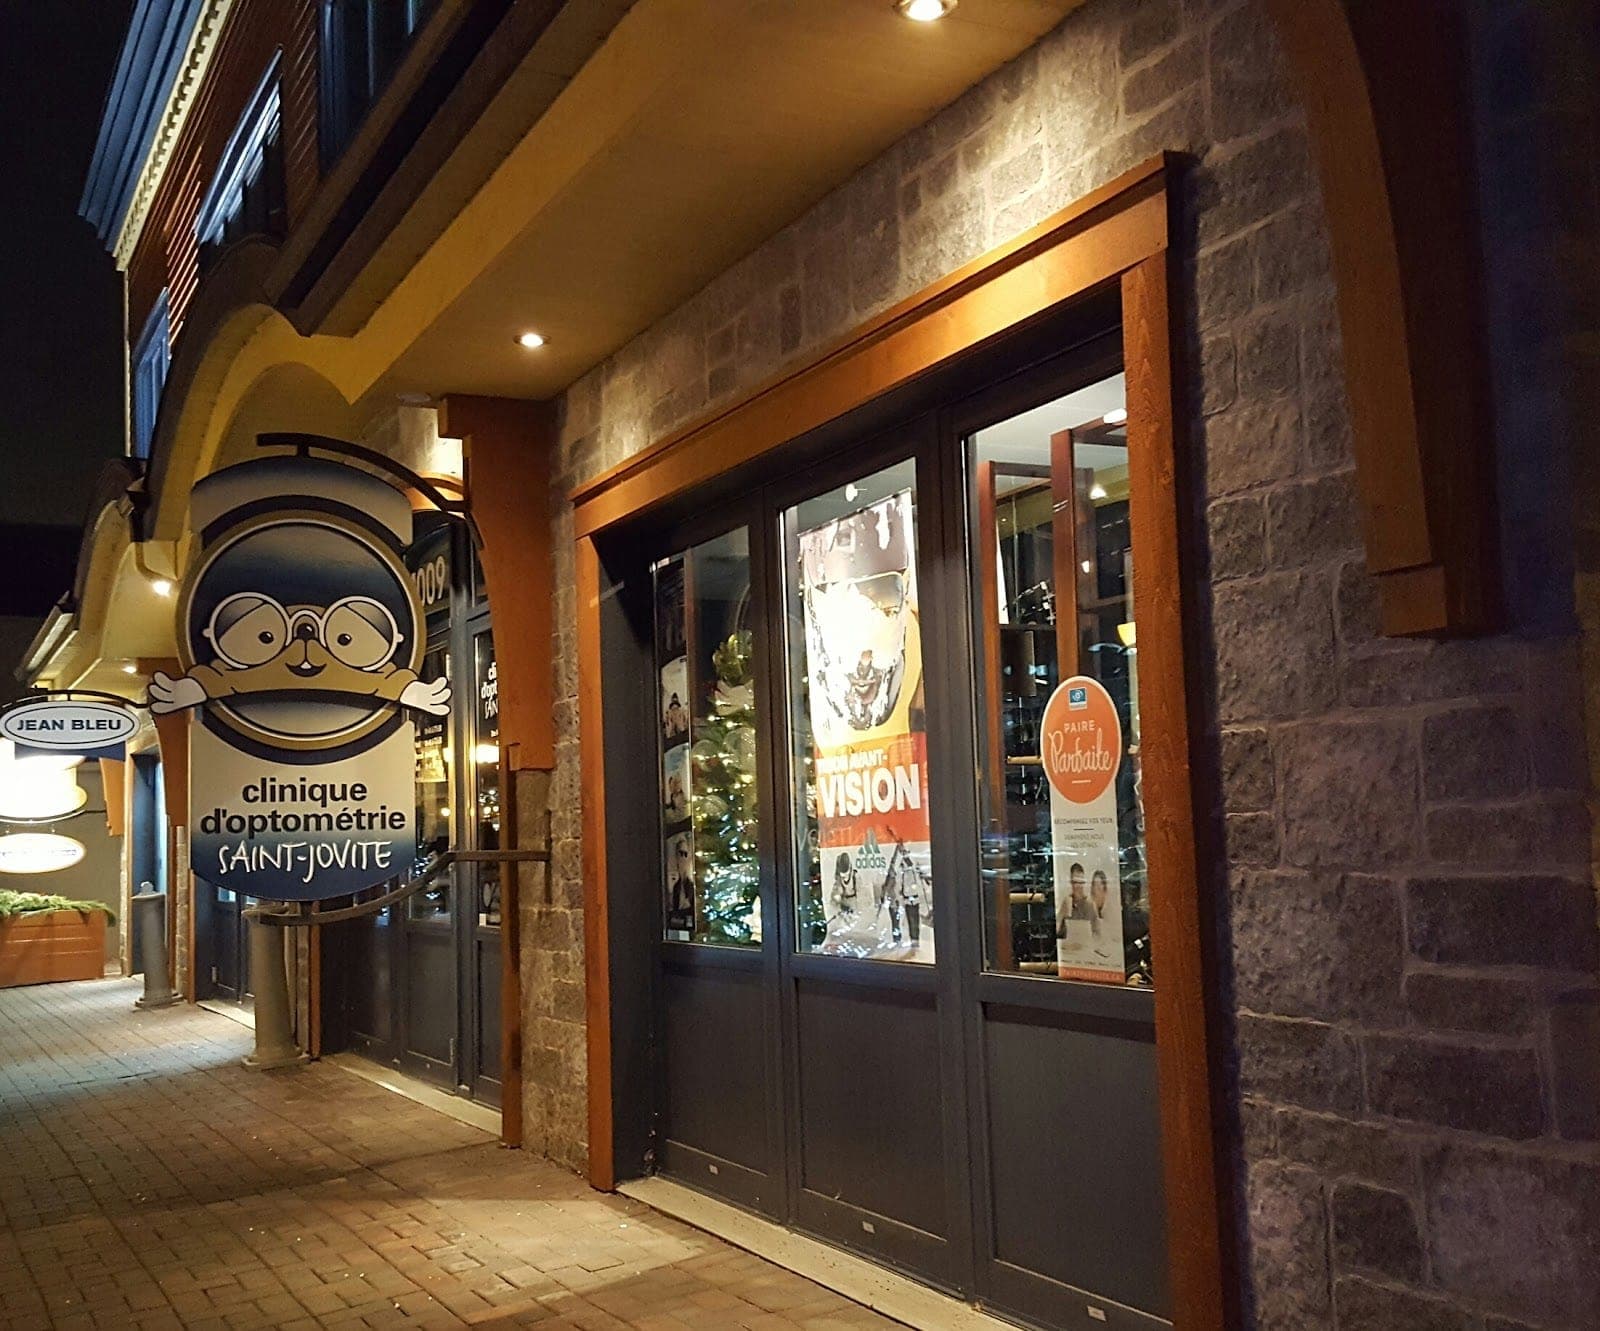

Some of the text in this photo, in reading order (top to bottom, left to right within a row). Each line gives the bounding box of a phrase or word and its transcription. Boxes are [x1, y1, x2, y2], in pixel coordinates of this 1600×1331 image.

[411, 555, 446, 607] 009
[17, 719, 121, 731] JEAN BLEU
[1063, 719, 1096, 734] PAIRE
[1047, 727, 1113, 774] Parfaite
[242, 777, 368, 808] clinique
[818, 763, 921, 818] VISION
[200, 805, 406, 840] d'optométrie
[218, 839, 392, 884] SAINT-JOVITE
[855, 854, 887, 869] adidas
